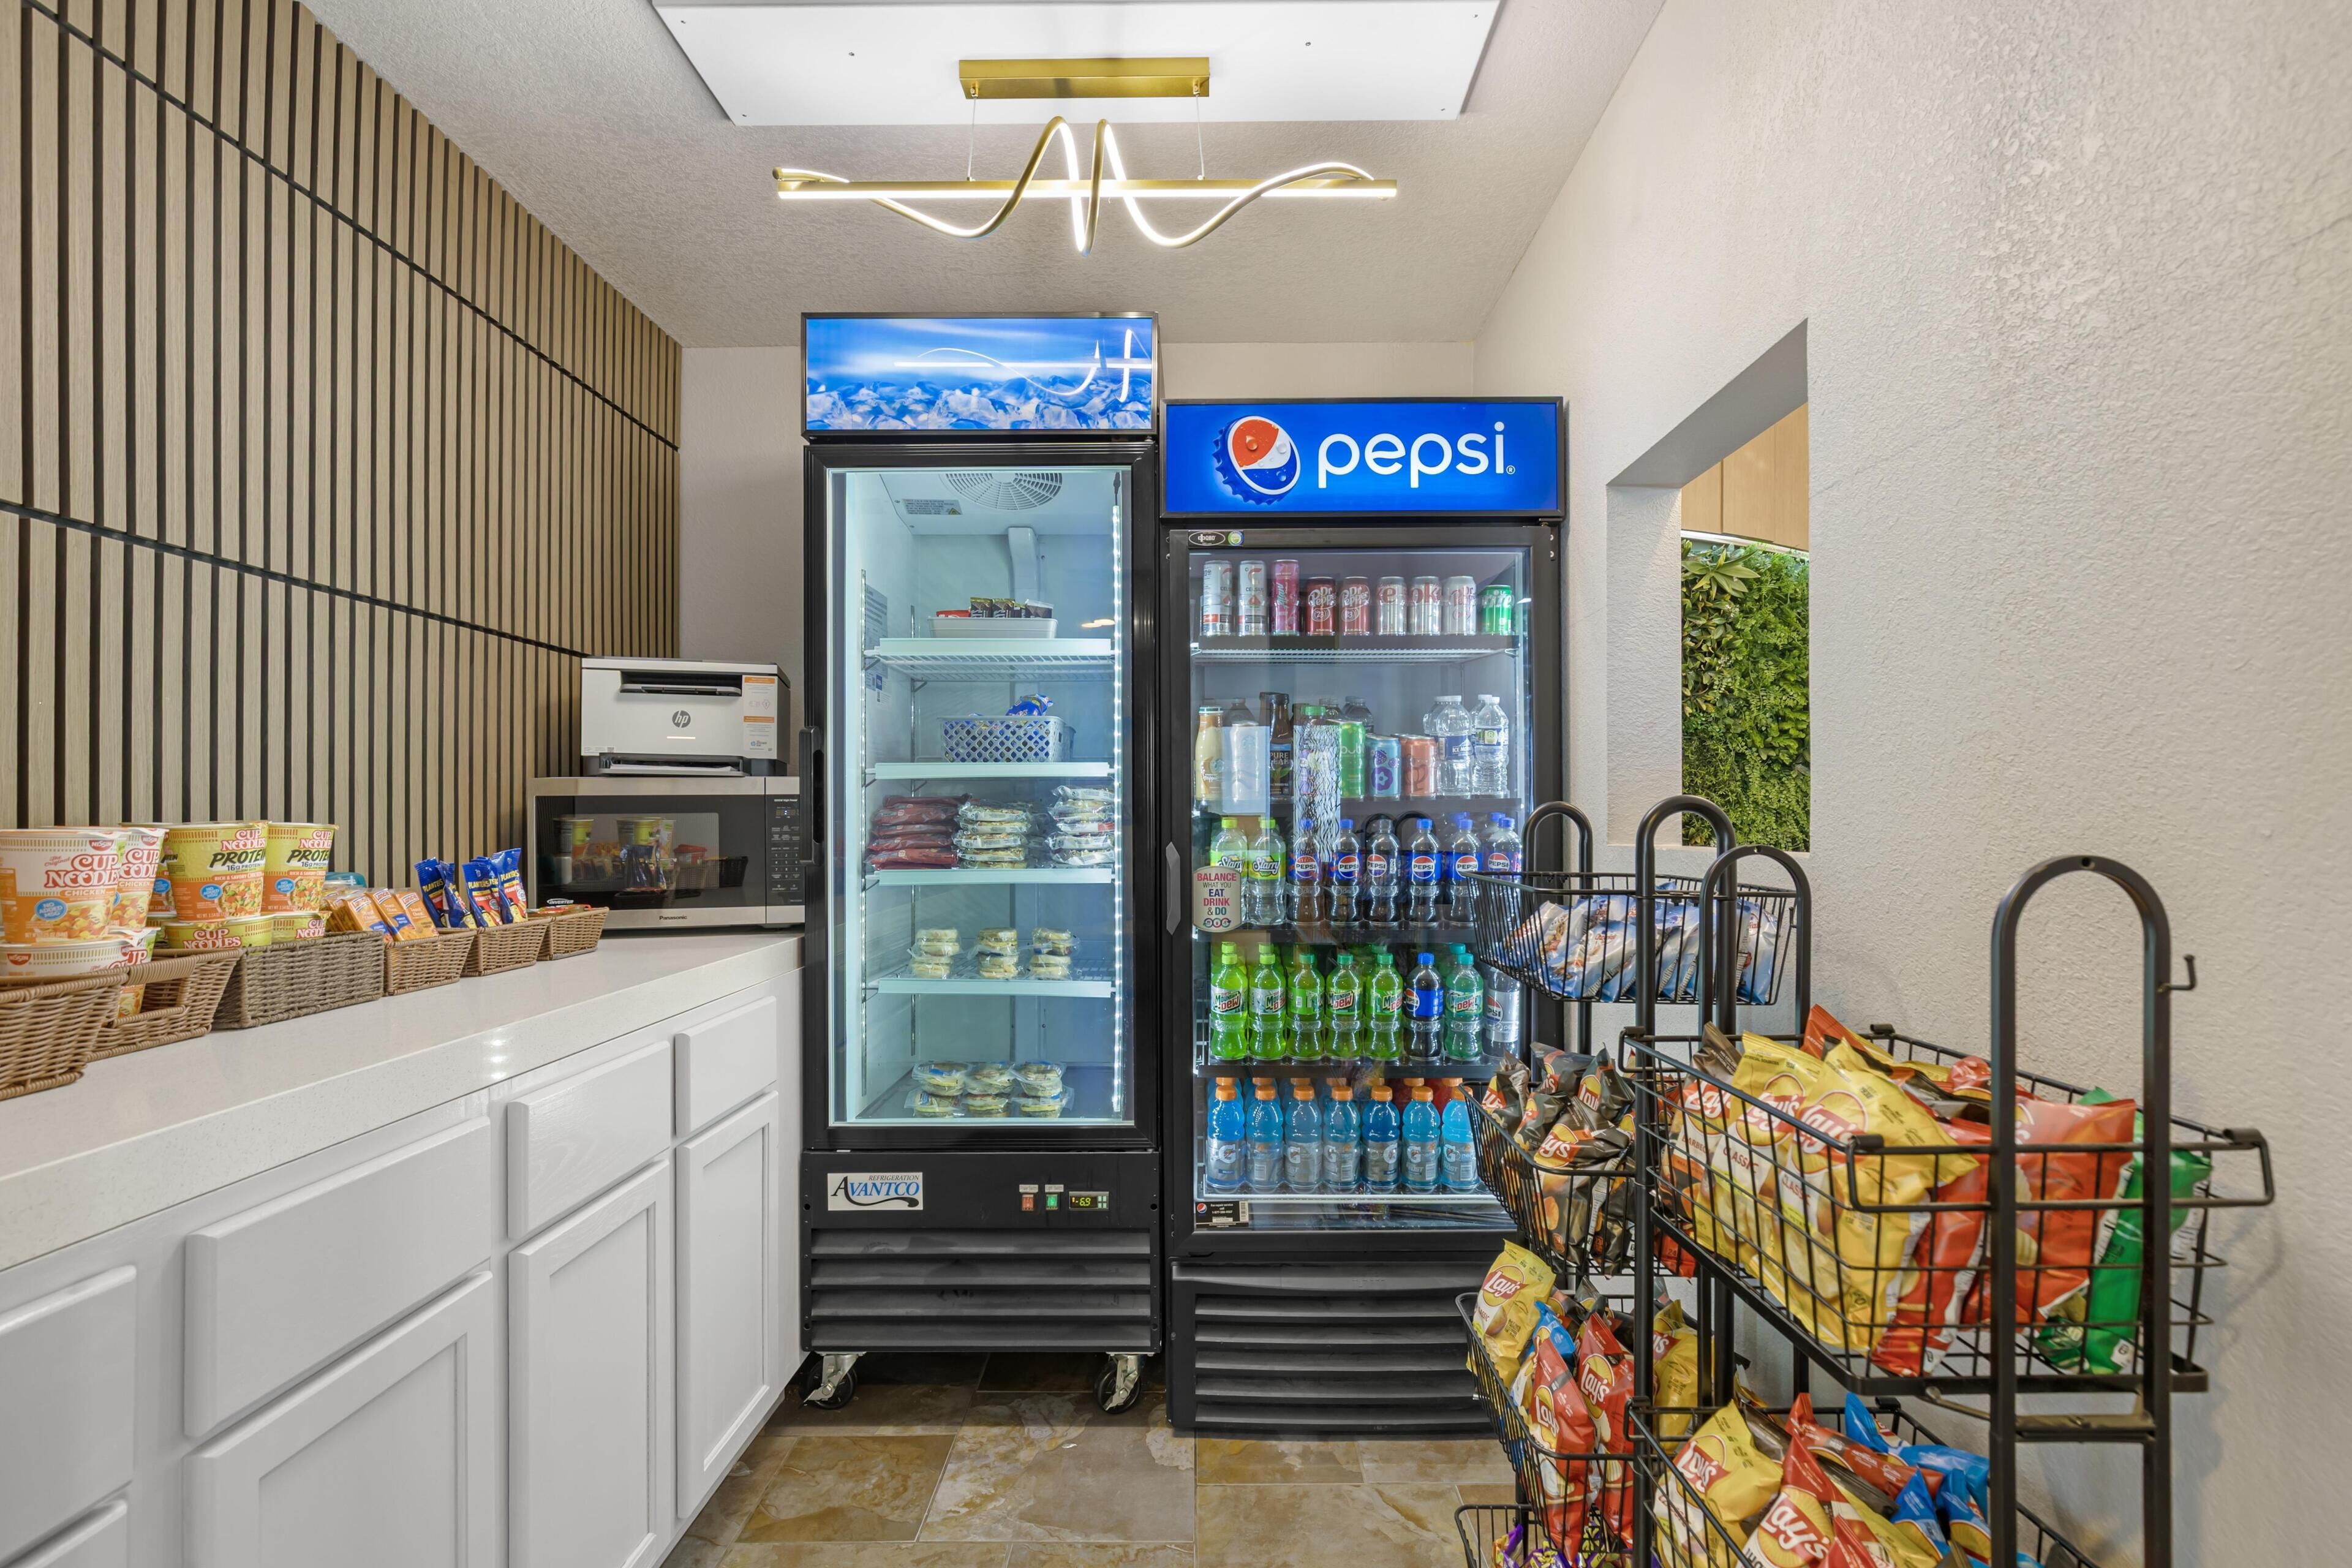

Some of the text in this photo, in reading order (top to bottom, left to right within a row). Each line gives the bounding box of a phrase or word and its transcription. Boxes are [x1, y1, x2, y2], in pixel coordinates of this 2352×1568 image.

[1349, 586, 1362, 596] Dr
[1340, 590, 1368, 607] Pepper
[235, 829, 262, 840] CUP
[312, 830, 331, 840] CUP
[221, 838, 265, 851] NOODLES
[126, 848, 160, 864] CUP
[72, 854, 119, 872] CUP
[1253, 857, 1280, 875] Starry
[500, 869, 520, 882] PLANTERS
[1197, 873, 1237, 881] BALANCE
[423, 878, 444, 892] PLANTERS
[467, 880, 490, 889] PLANTERS
[194, 929, 229, 940] CUP
[183, 936, 241, 949] NOODLES
[1488, 1008, 1501, 1017] PSI
[831, 1176, 920, 1200] AVANTCO
[1484, 1270, 1521, 1298] Lay's
[1581, 1363, 1610, 1406] Lay's
[1676, 1440, 1719, 1493] Lay's
[1760, 1491, 1829, 1559] Lay's
